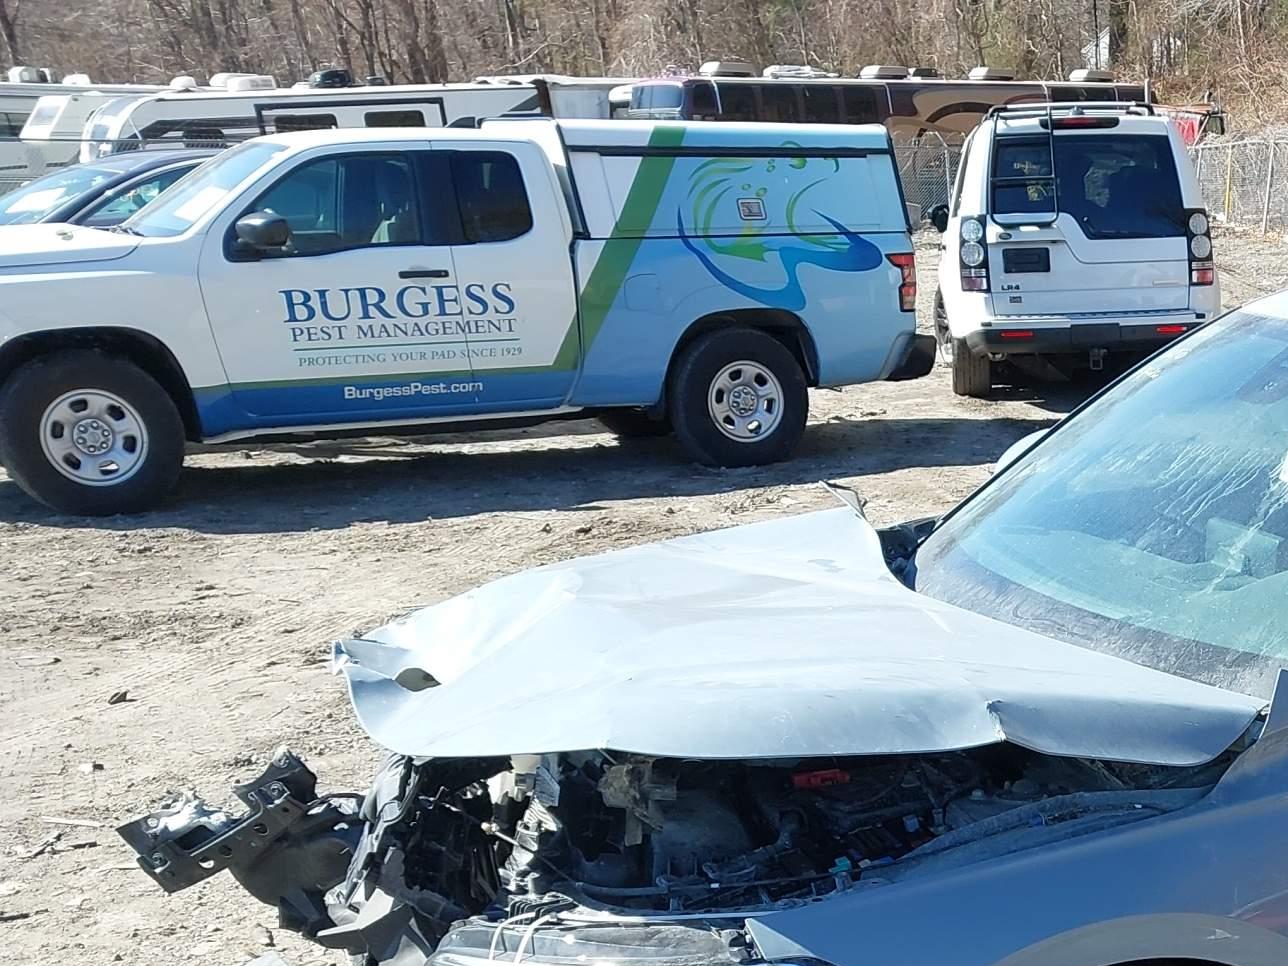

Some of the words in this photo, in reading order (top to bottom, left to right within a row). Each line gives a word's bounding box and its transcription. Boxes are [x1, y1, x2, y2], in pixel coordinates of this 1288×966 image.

[278, 283, 516, 323] BURGESS
[290, 325, 347, 342] PEST
[356, 318, 517, 339] MANAGEMENT
[299, 353, 386, 367] PROTECTING
[391, 351, 427, 362] YOUR
[431, 350, 456, 360] PAD
[460, 348, 497, 359] SINCE
[501, 347, 523, 357] 1929
[344, 381, 483, 400] BurgessPest.com
